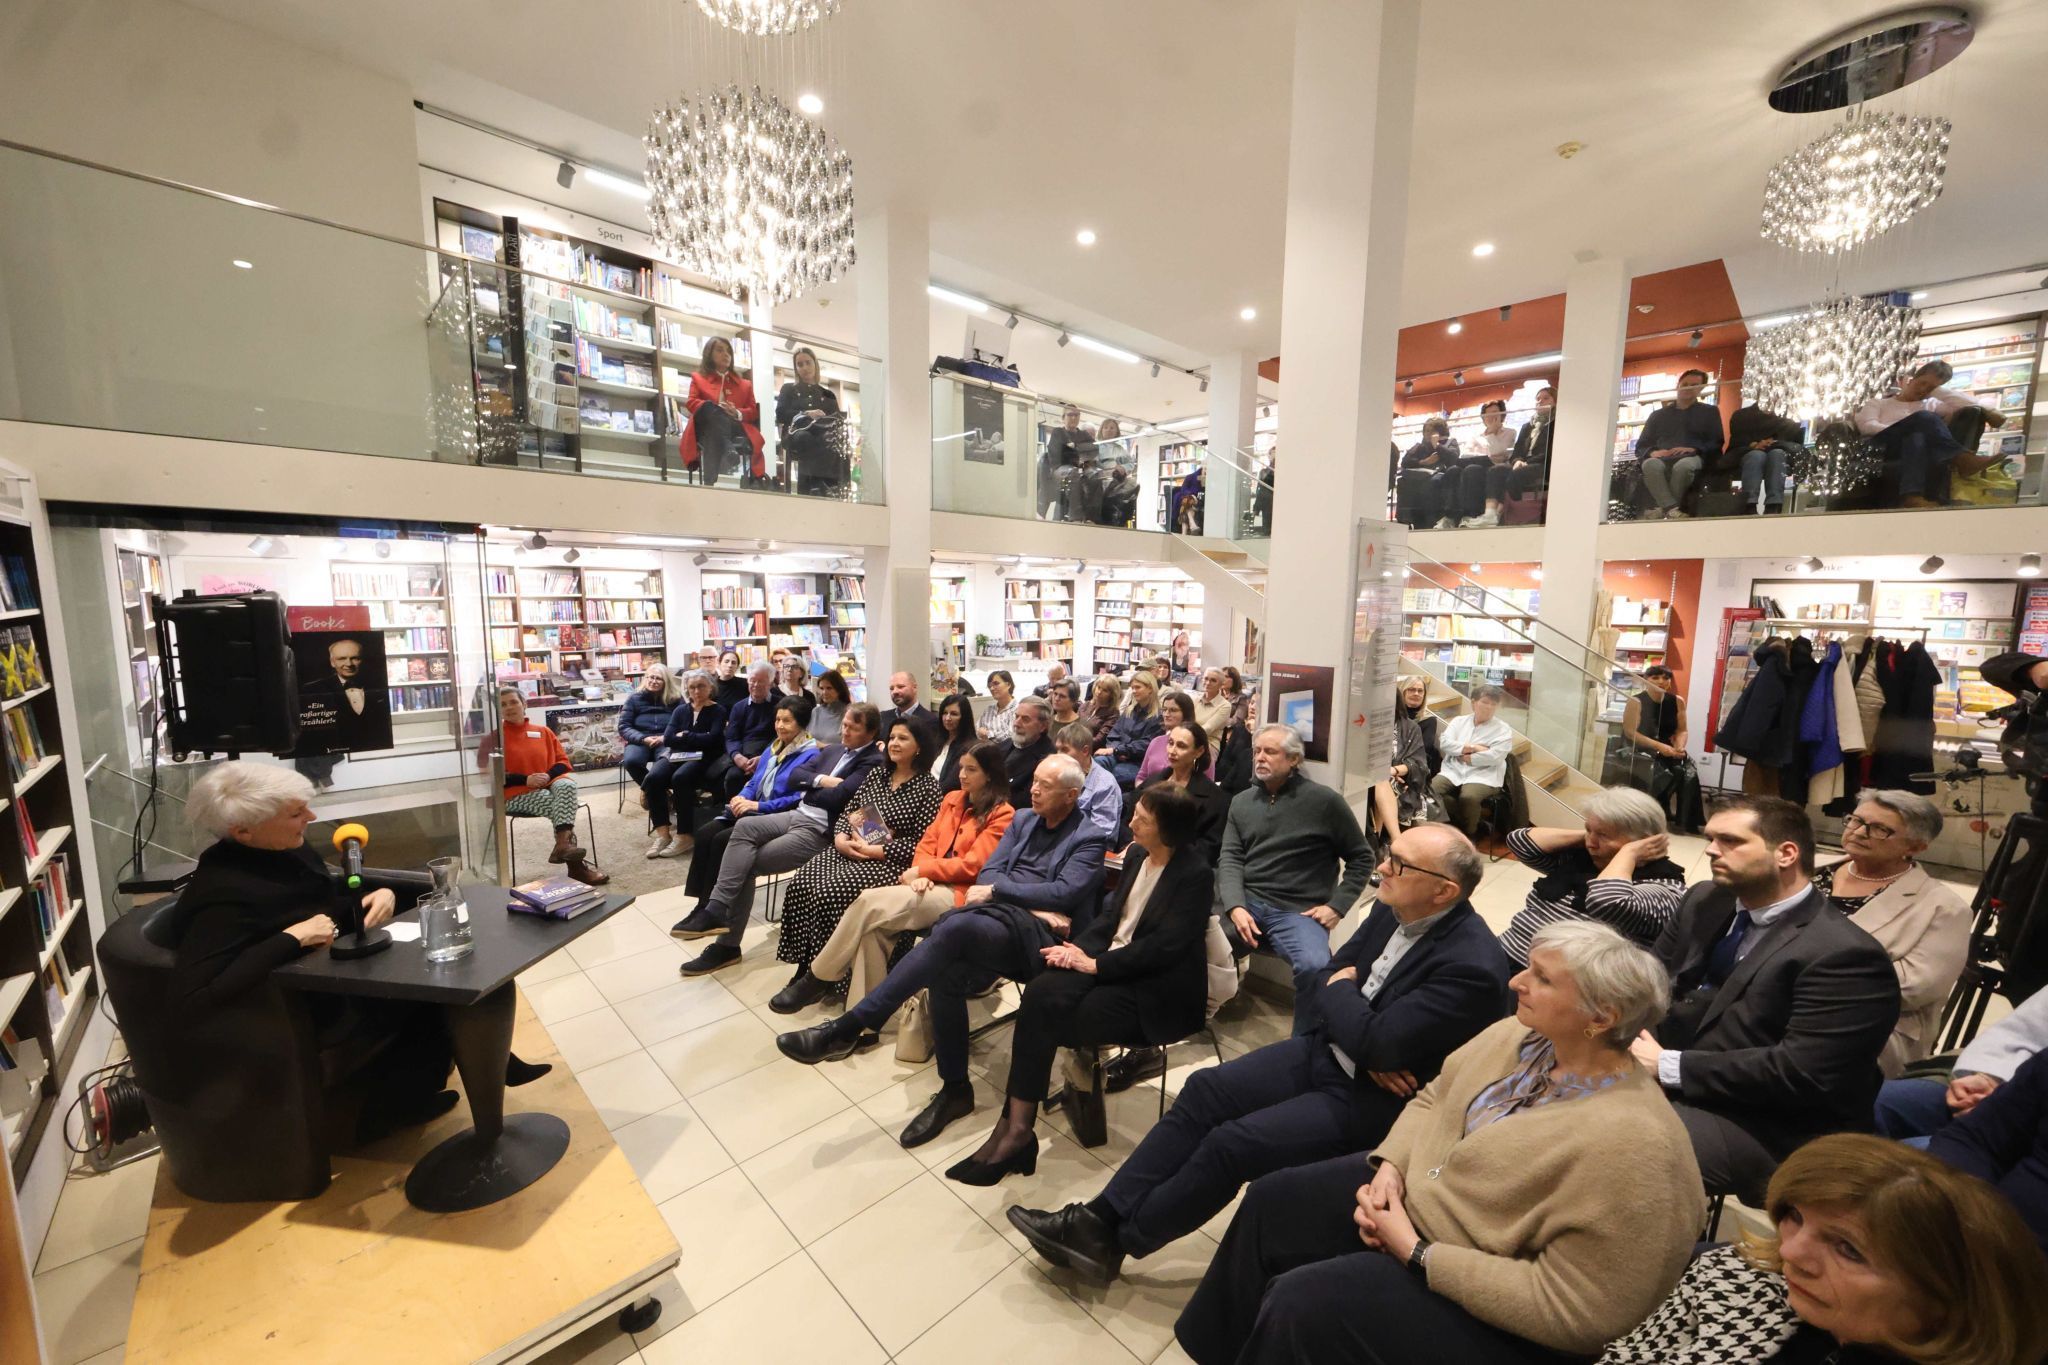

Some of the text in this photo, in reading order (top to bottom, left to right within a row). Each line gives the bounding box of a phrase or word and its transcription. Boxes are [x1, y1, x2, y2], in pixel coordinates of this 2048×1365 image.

[598, 228, 624, 243] Sport
[301, 616, 345, 630] Books
[300, 710, 338, 719] roßartiger
